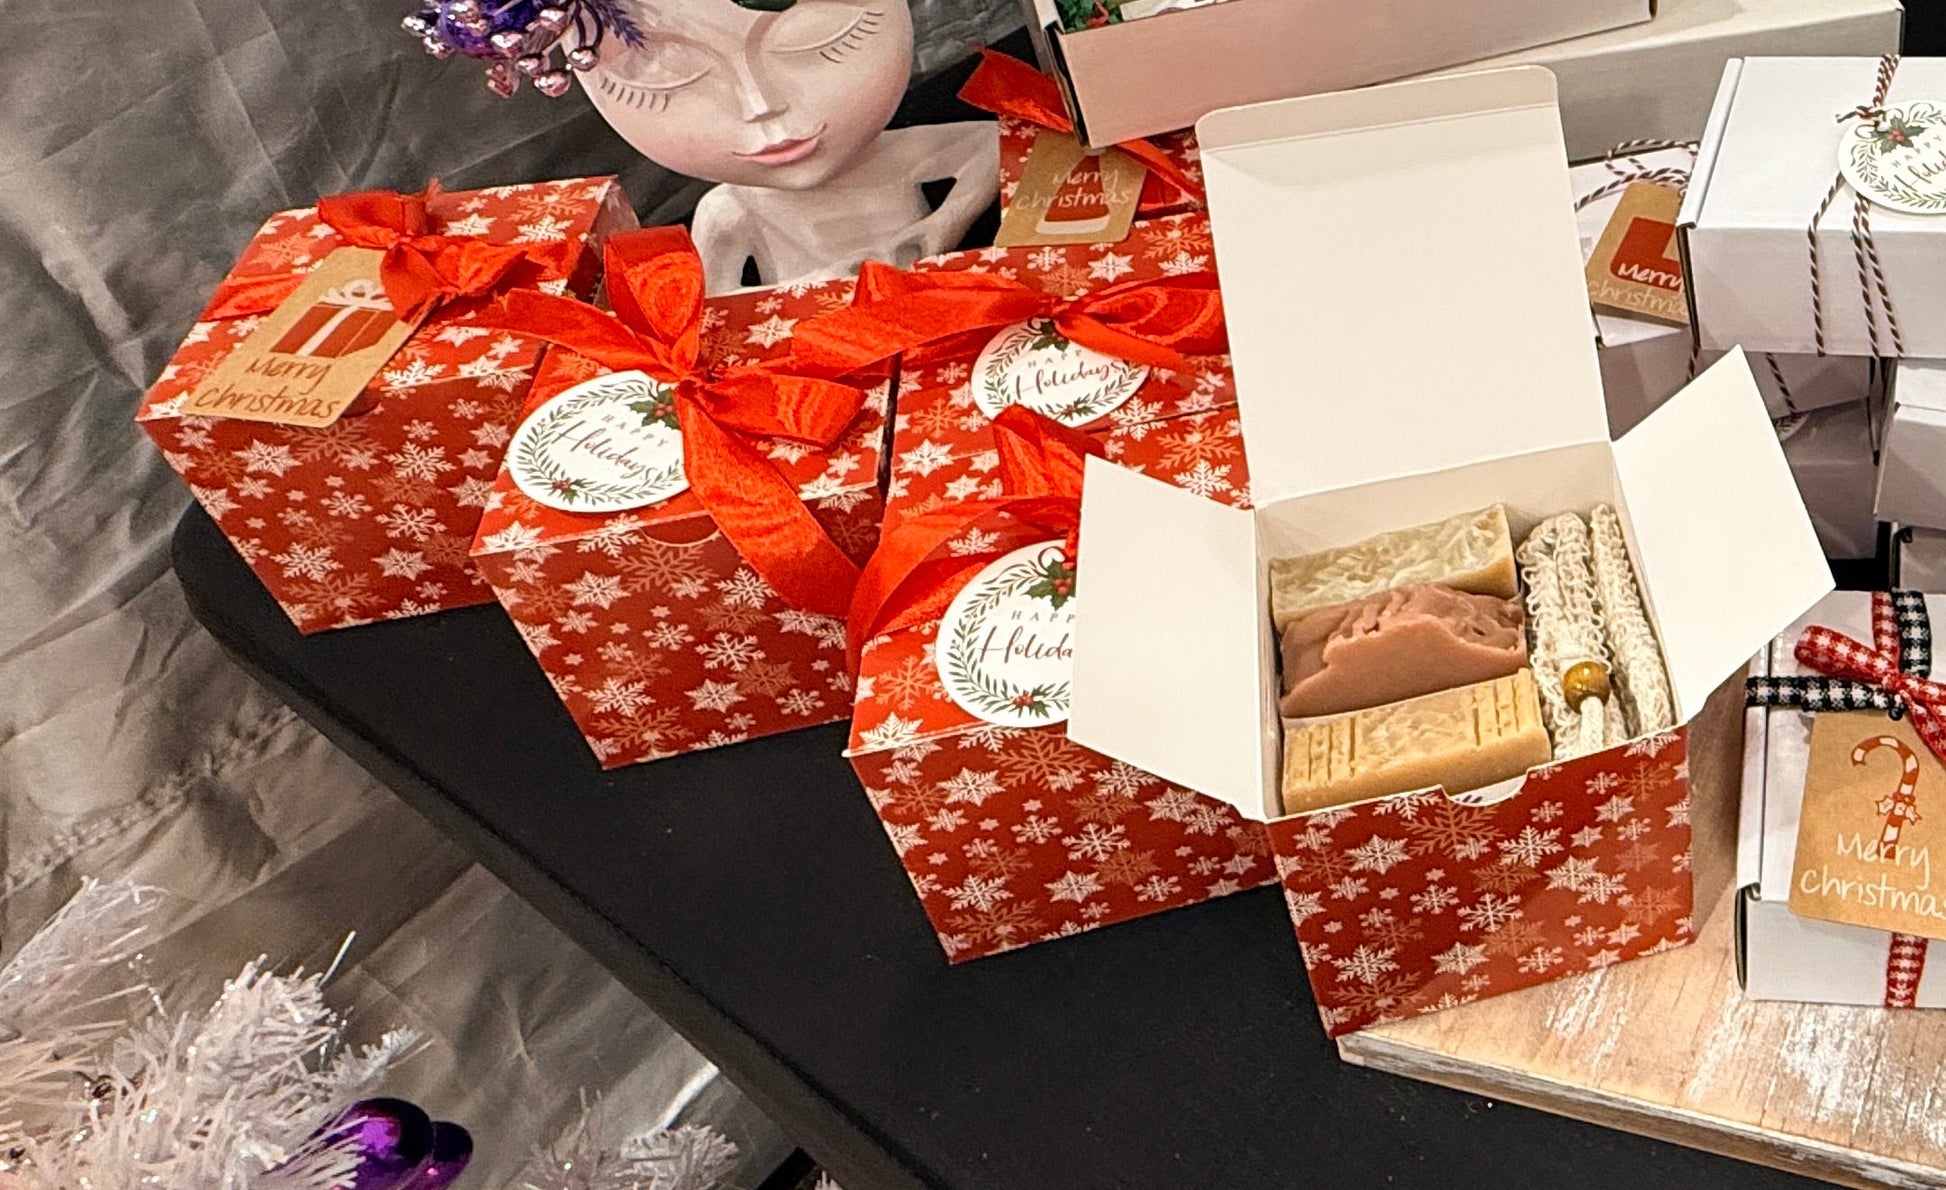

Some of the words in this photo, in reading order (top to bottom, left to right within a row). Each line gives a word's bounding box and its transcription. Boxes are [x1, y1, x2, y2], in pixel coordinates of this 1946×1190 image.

[1051, 169, 1119, 190] Merry
[1894, 150, 1946, 192] Holi
[1617, 262, 1685, 298] Merry
[245, 356, 332, 395] Merry
[1027, 350, 1082, 368] HAPP
[601, 413, 669, 448] HAPPY
[1011, 610, 1076, 623] HAPP
[978, 624, 1073, 664] Holida
[1836, 832, 1930, 891] Merry
